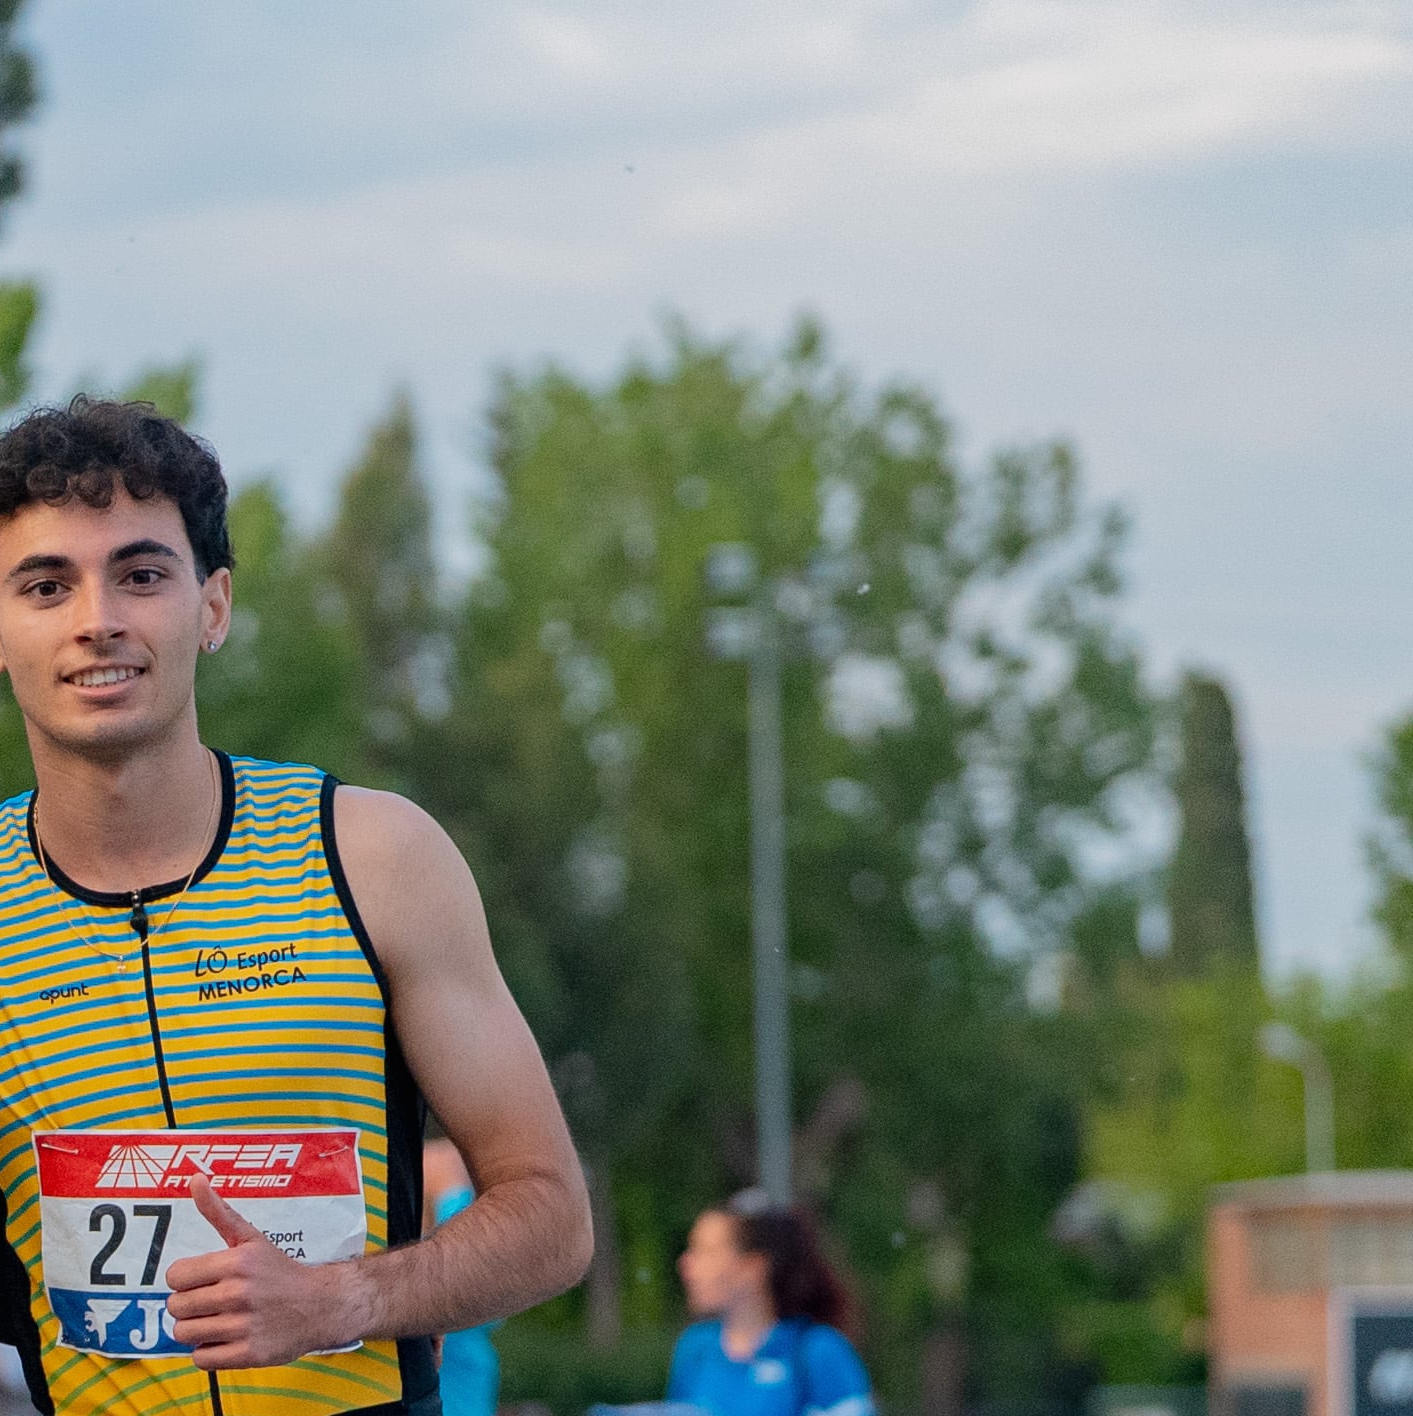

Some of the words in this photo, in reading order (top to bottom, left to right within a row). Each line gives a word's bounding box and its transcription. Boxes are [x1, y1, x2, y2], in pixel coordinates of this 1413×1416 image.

[237, 942, 298, 971] Esport
[39, 983, 90, 1004] apunt
[198, 965, 307, 1002] MENORCA
[171, 1143, 303, 1175] RFEA
[163, 1174, 292, 1188] ATETISMO
[88, 1204, 173, 1287] 27
